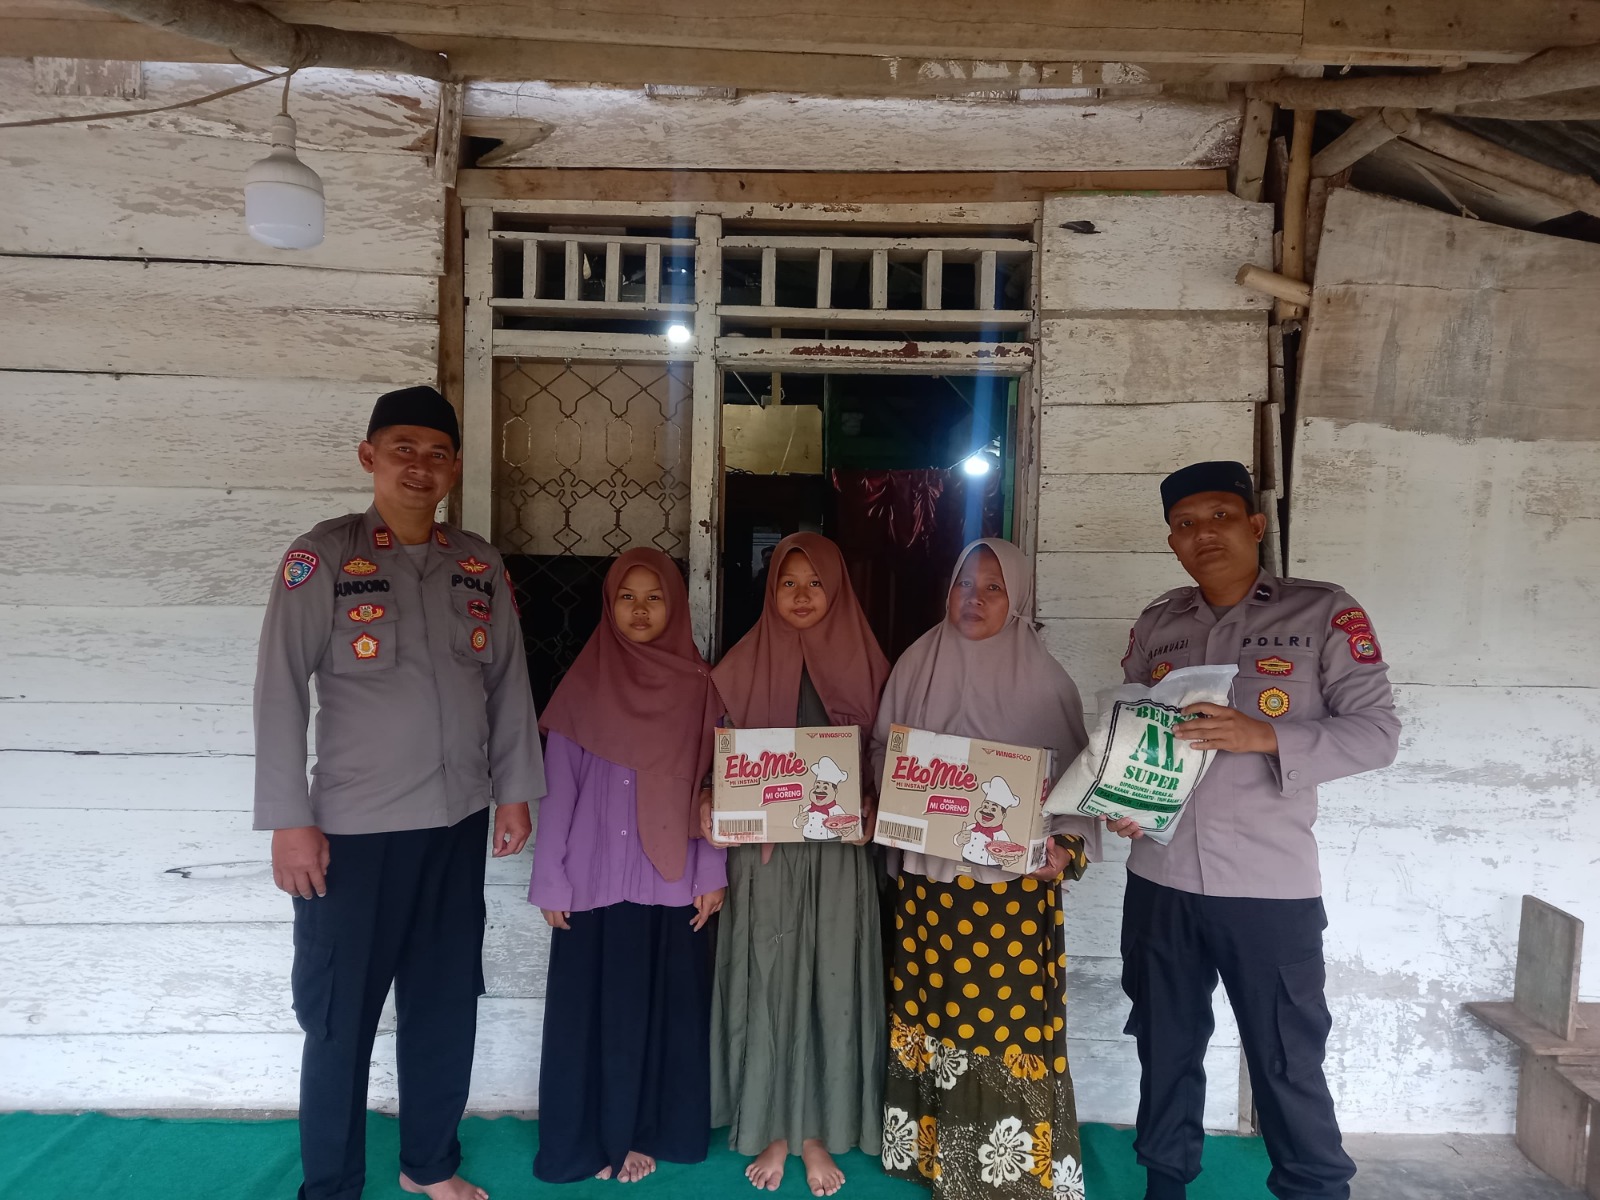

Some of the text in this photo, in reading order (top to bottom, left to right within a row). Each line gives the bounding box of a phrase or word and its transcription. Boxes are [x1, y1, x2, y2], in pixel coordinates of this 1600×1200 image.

[1242, 635, 1311, 648] POLRI
[1128, 723, 1184, 773] AL
[995, 750, 1032, 762] WINGSFOOD
[724, 751, 806, 780] EkoMie
[891, 756, 977, 789] EkoMie
[1123, 765, 1180, 791] SUPER
[765, 790, 801, 800] MI GORENG
[929, 801, 968, 813] MI GORENG
[1086, 804, 1105, 815] NETT
